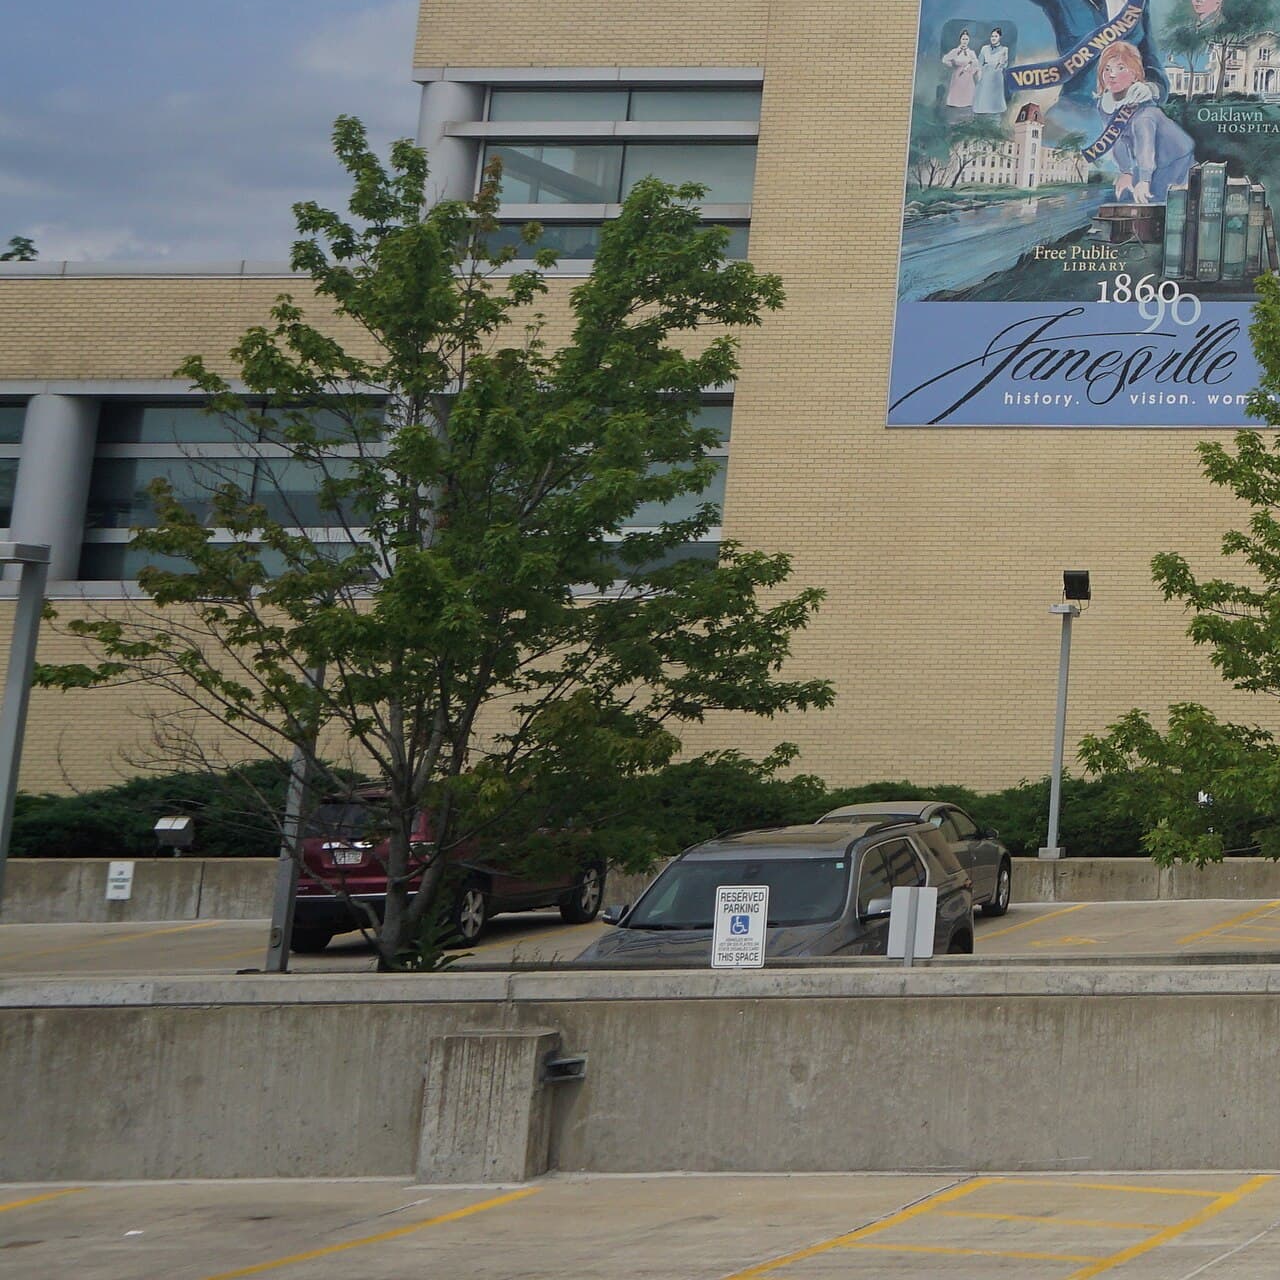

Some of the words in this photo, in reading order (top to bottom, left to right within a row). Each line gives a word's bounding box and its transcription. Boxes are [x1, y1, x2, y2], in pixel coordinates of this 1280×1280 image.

[1012, 67, 1061, 87] VOTES
[1064, 46, 1095, 75] FOR
[1088, 5, 1143, 51] WOMEN
[1197, 107, 1264, 122] Oaklawn
[1086, 124, 1121, 159] VOTE
[1033, 245, 1067, 261] Free
[1071, 245, 1119, 261] Public
[1063, 261, 1128, 272] LIBRARY
[1096, 273, 1180, 304] 1860
[1137, 292, 1202, 336] 90
[888, 307, 1241, 425] Janesville
[1004, 391, 1080, 407] history.
[1130, 390, 1197, 406] vision.
[720, 892, 765, 902] RESERVED
[723, 903, 760, 913] PARKING
[717, 952, 734, 962] THIS
[735, 952, 759, 962] SPACE
